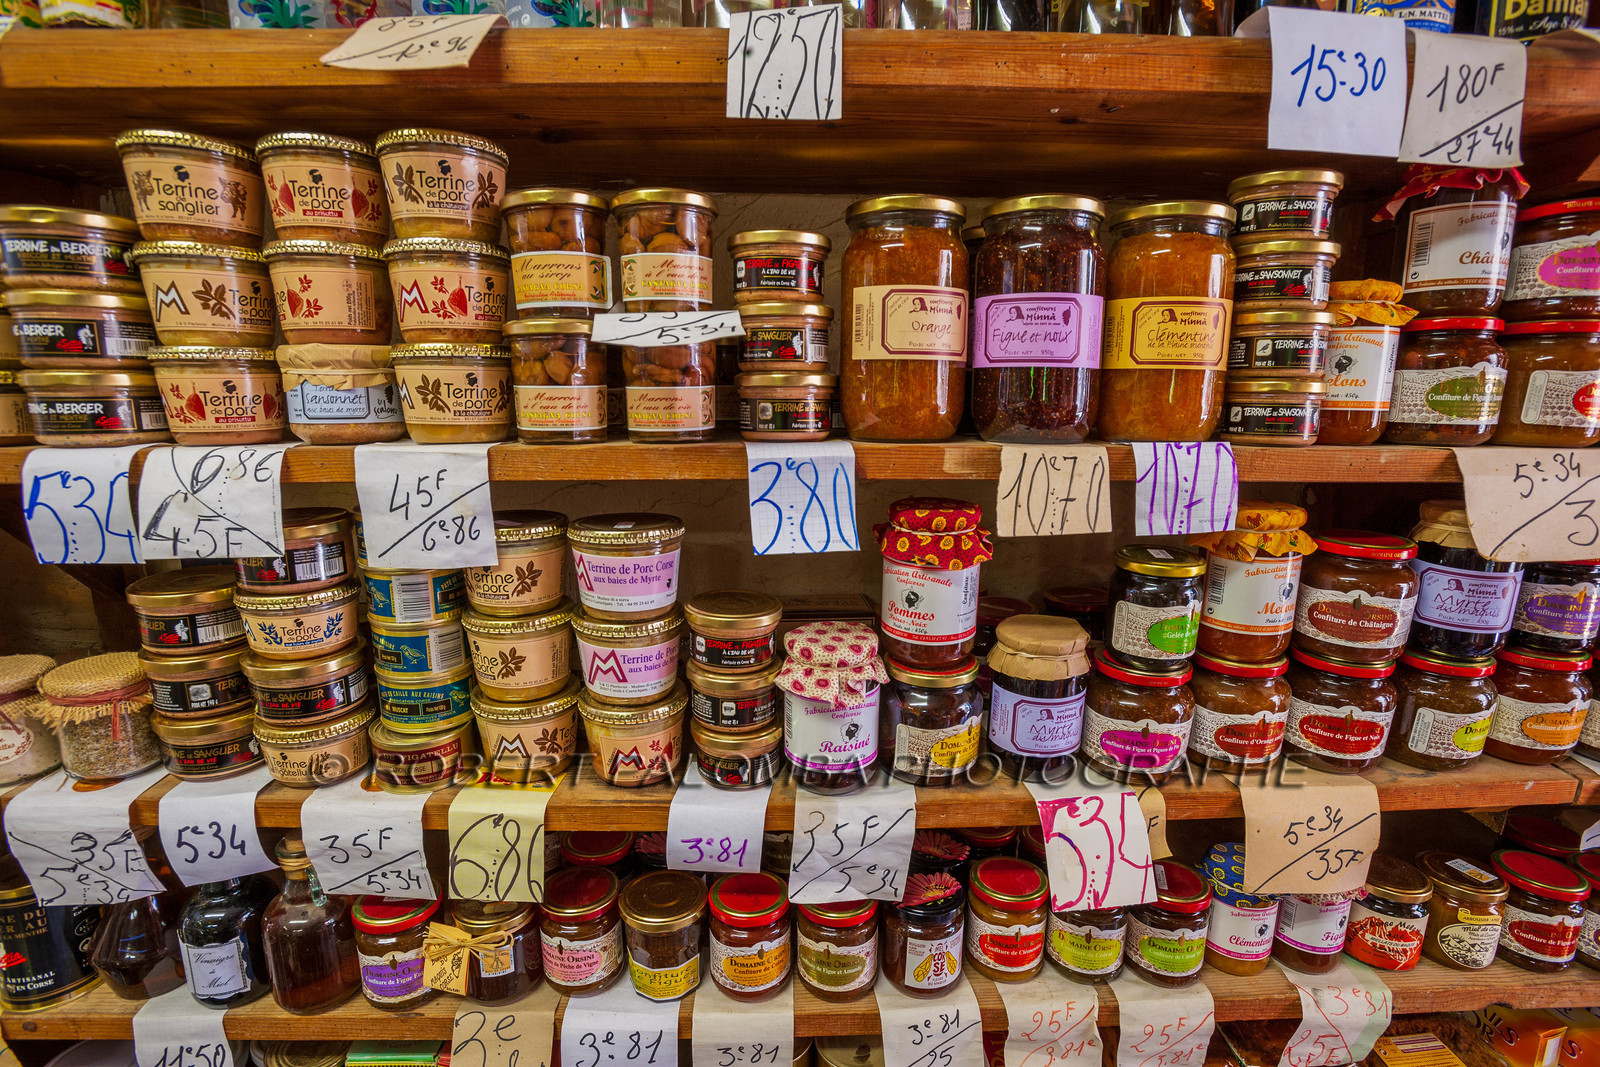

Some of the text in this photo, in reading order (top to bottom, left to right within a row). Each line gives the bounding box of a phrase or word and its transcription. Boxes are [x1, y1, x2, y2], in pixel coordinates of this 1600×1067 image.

[416, 170, 476, 192] Terrine
[152, 178, 219, 200] Terrine
[289, 180, 350, 200] Terrine
[426, 189, 470, 203] de porc
[158, 200, 220, 216] sanglier
[299, 199, 344, 210] de porc
[1257, 201, 1287, 212] TERRINE
[60, 241, 112, 258] BERGER
[516, 258, 581, 272] Marrons
[653, 259, 704, 271] Marrons
[745, 258, 773, 269] TERRINE
[1260, 269, 1302, 280] SANSONNET
[1556, 266, 1593, 274] Confiture
[538, 272, 570, 281] sirop
[465, 285, 506, 305] Terrine
[472, 303, 504, 315] de porc
[23, 324, 64, 336] BERGER
[912, 320, 952, 341] Orange
[1148, 326, 1216, 342] Clémentine
[758, 331, 792, 342] SANGLIER
[992, 328, 1041, 351] Figue et
[1274, 340, 1304, 349] TERRINE
[444, 382, 498, 398] Terrine
[199, 391, 262, 406] Terrine
[528, 392, 582, 402] Marrons
[634, 392, 684, 402] Marrons
[1428, 393, 1463, 401] Confiture
[56, 402, 104, 415] BERGER
[465, 399, 492, 410] porc
[774, 403, 804, 412] TERRINE
[210, 405, 257, 418] de porc
[1243, 407, 1272, 417] TERRINE
[390, 468, 448, 520] 45F
[586, 560, 674, 574] Terrine de Porc Corse
[608, 576, 627, 584] baies
[640, 574, 661, 585] Myrte
[910, 569, 954, 588] Artisanale
[482, 583, 509, 594] porc
[888, 600, 935, 622] Pommes
[1363, 609, 1393, 621] ORSINI
[1527, 606, 1558, 617] Confiture
[1313, 611, 1393, 630] Confiture de Châtaigne
[280, 624, 321, 637] Terrine
[1167, 631, 1184, 639] Gelée
[287, 632, 318, 642] de porc
[706, 637, 770, 648] TERRINE FIGATELLU
[622, 652, 664, 664] Terrine de
[643, 662, 660, 672] baies
[277, 688, 324, 701] SANGLIER
[1219, 734, 1249, 744] Confiture
[1303, 724, 1335, 736] Confiture
[1336, 731, 1344, 739] de
[1345, 733, 1360, 742] Figue
[818, 733, 872, 753] Raisiné
[1102, 737, 1125, 750] Confiture
[1132, 746, 1146, 754] Figue
[193, 744, 240, 759] SANGLIER
[933, 750, 962, 758] Confiture
[272, 758, 307, 769] Terrine
[320, 827, 393, 864] 35F
[1514, 928, 1554, 945] Confiture de
[984, 943, 1010, 956] Confiture
[1147, 939, 1184, 954] DOMAINE
[567, 954, 595, 964] ORSINI
[932, 951, 946, 962] COR
[730, 958, 766, 968] DOMAINE
[932, 962, 946, 973] SE
[734, 966, 762, 976] Confiture
[6, 971, 55, 984] ARTISANAL
[27, 979, 55, 990] CORSE
[1130, 1017, 1189, 1054] 25F
